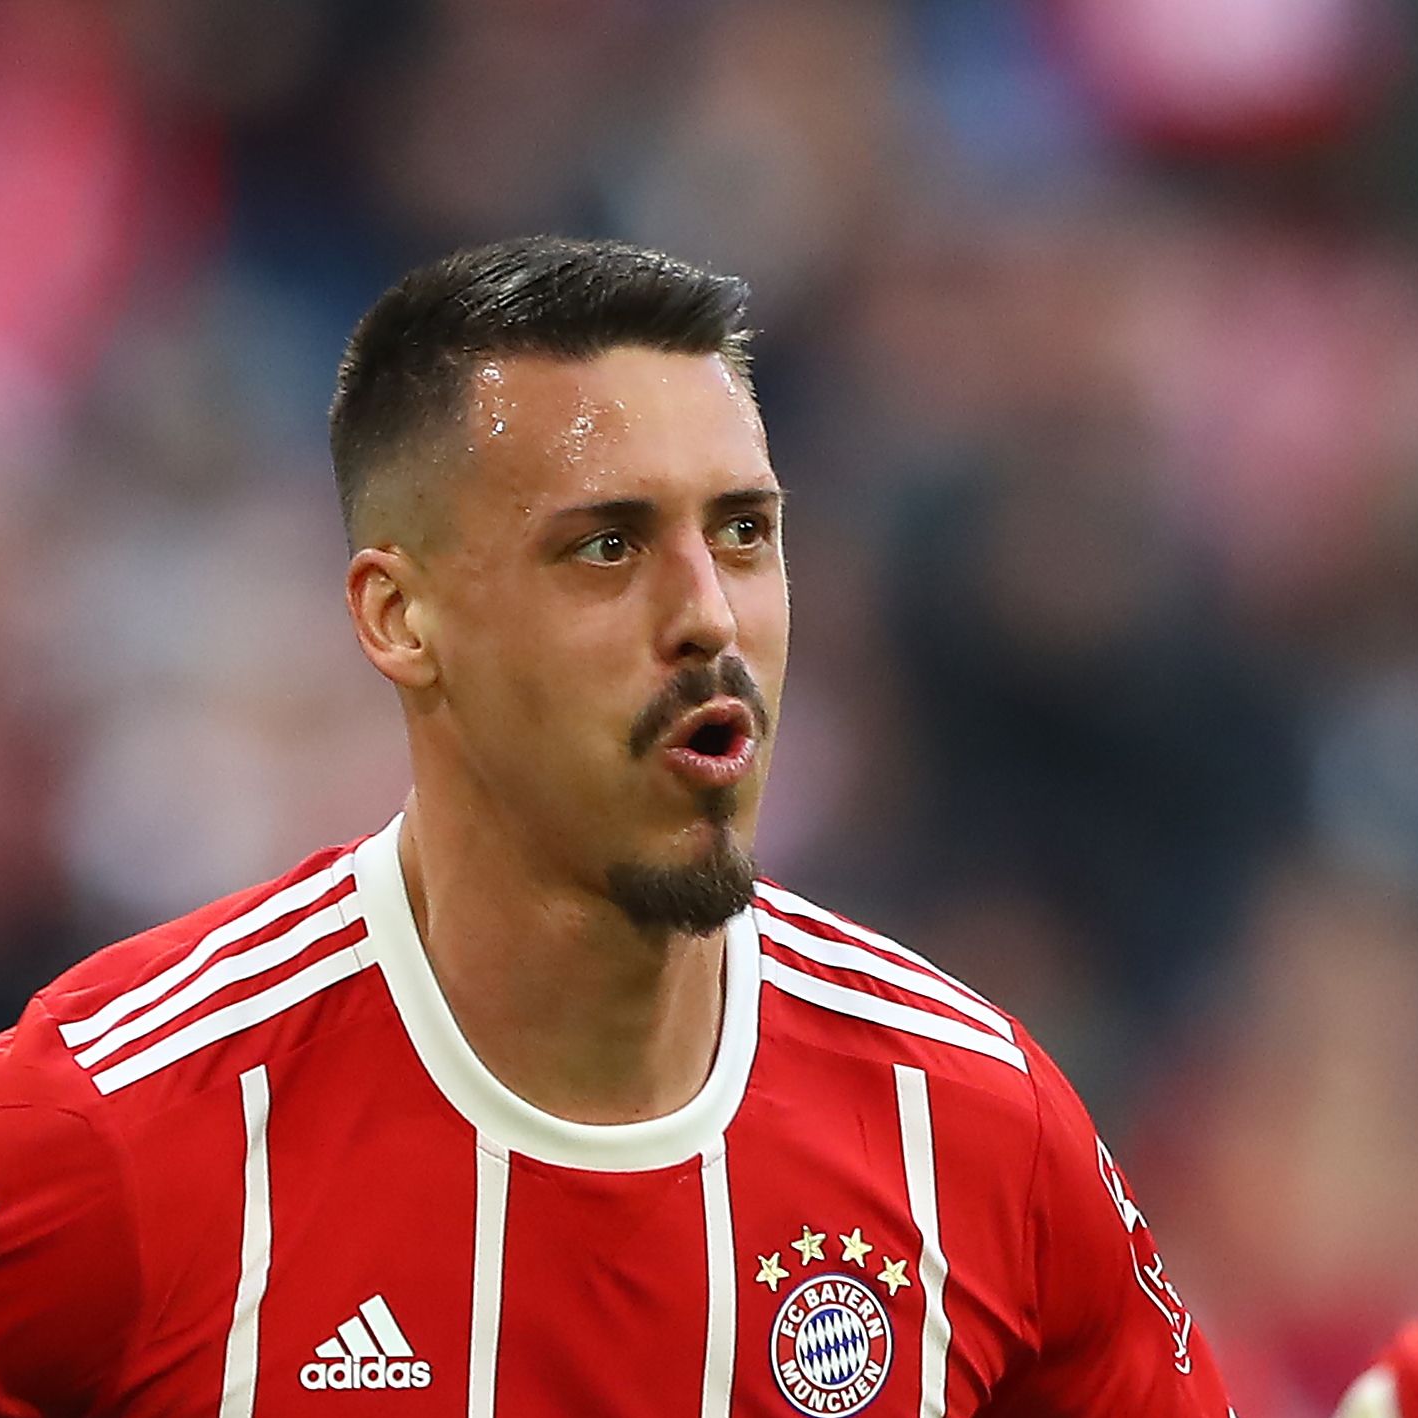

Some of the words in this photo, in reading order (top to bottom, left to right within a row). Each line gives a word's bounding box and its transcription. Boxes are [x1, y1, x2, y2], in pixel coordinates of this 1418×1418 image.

[780, 1304, 805, 1339] FC
[803, 1283, 884, 1340] BAYERN
[299, 1354, 432, 1390] adidas
